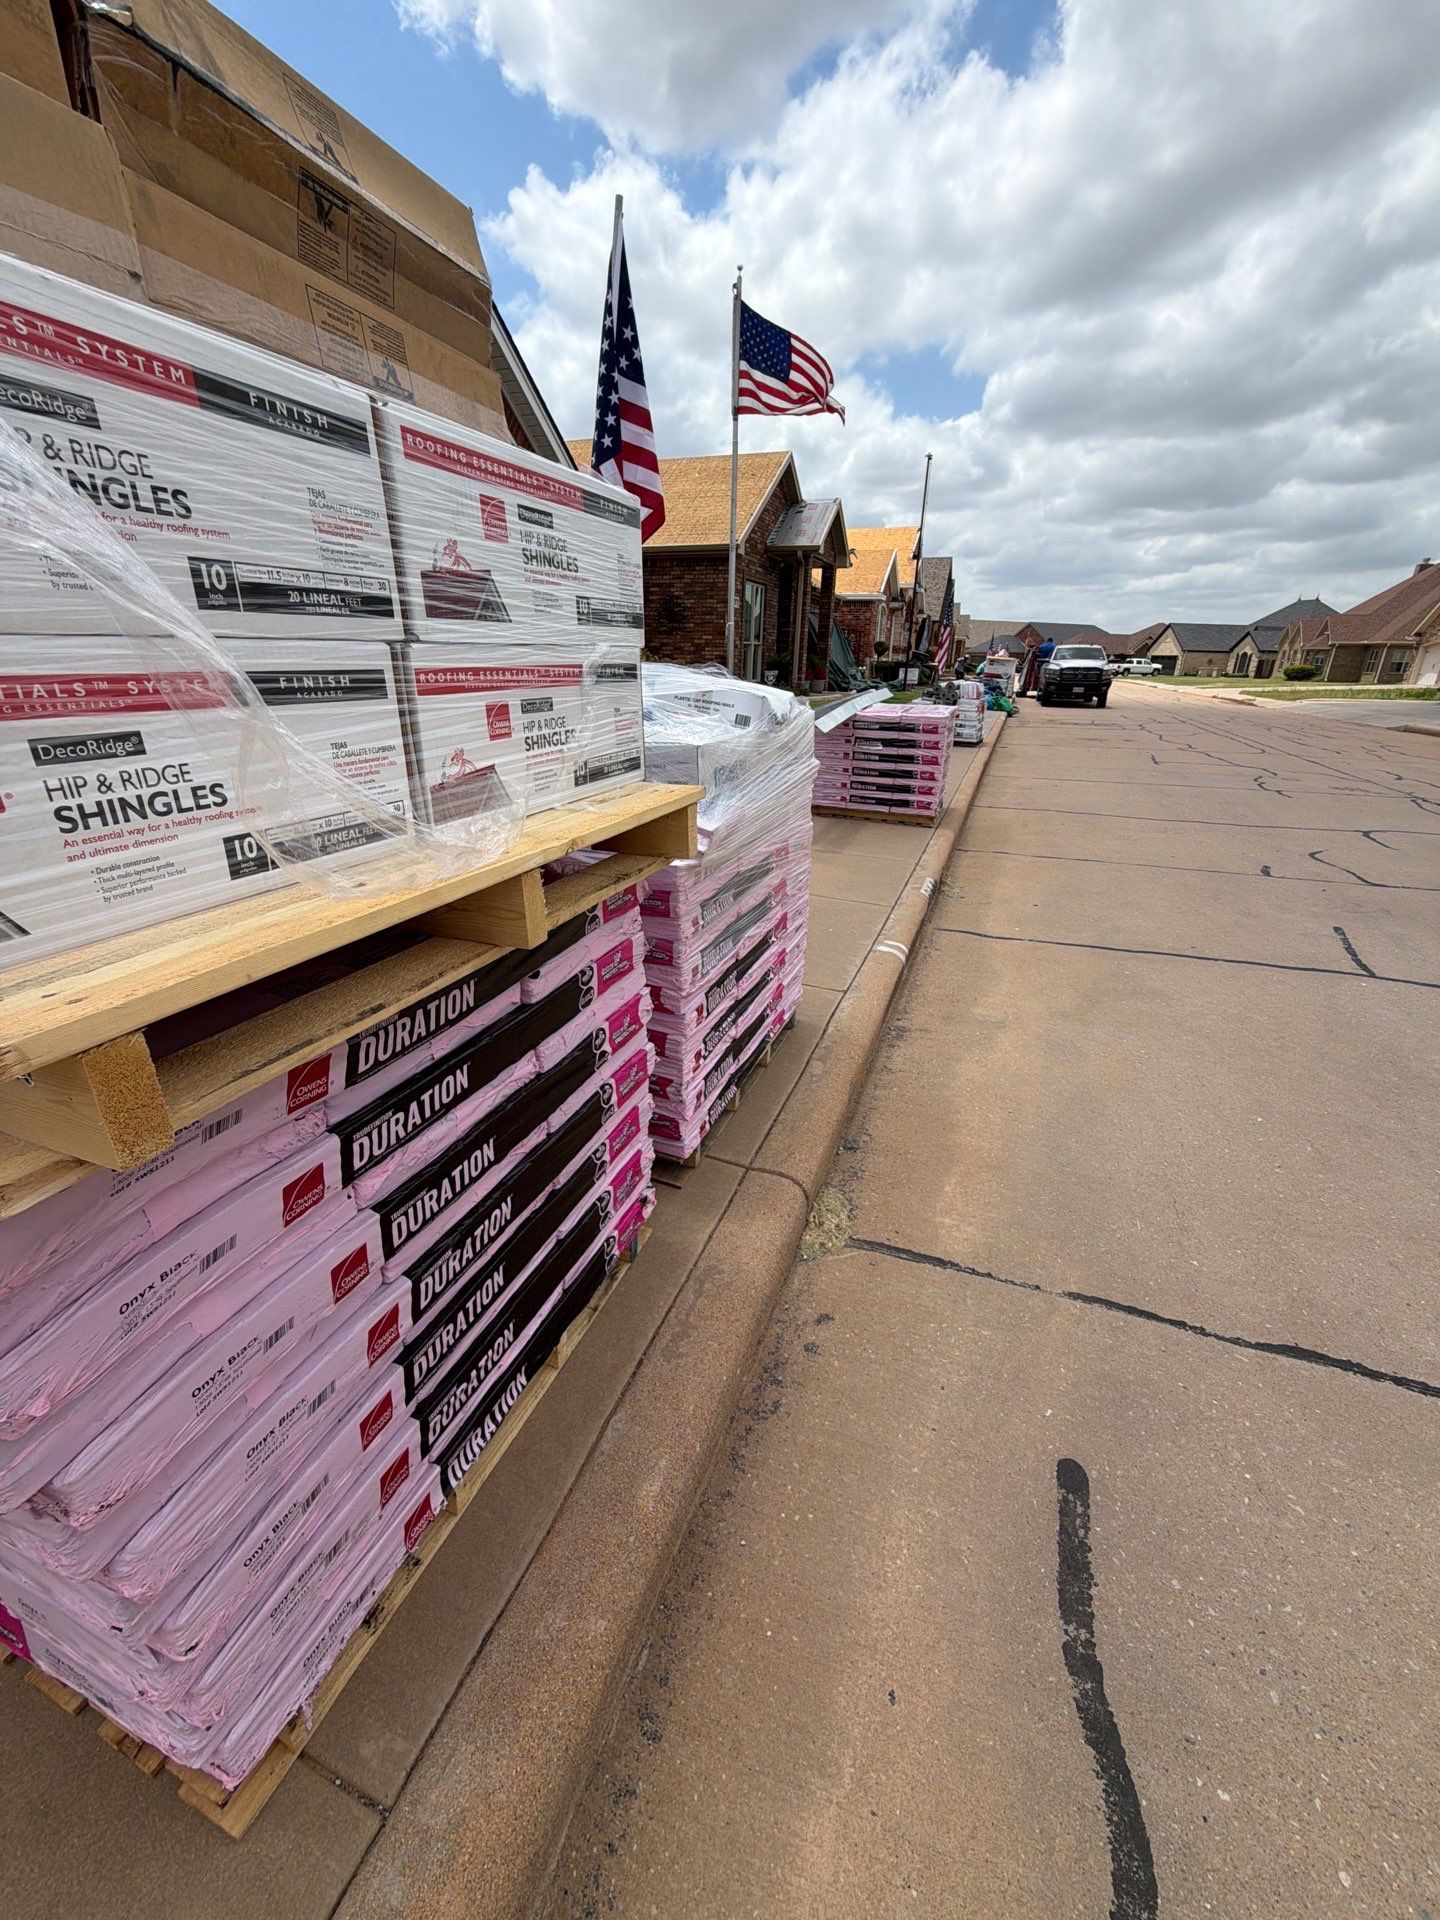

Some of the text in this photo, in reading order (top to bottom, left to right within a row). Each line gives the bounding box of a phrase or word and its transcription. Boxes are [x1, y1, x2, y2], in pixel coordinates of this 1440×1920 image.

[76, 336, 186, 385] SYSTEM
[249, 392, 329, 429] FINISH
[267, 416, 320, 437] ACABADO
[42, 433, 66, 463] &
[68, 438, 154, 480] RIDGE
[406, 433, 467, 463] ROOFING
[550, 482, 582, 499] SYSTEM
[52, 466, 193, 520] NGLES
[307, 487, 326, 499] TEJAS
[101, 511, 231, 540] for a healthy roofing system
[536, 533, 543, 547] &
[543, 533, 568, 553] RIDGE
[522, 547, 579, 573] SHINGLES
[51, 580, 88, 591] by trusted
[200, 562, 227, 591] 10
[267, 569, 282, 581] 11.5
[302, 573, 311, 584] 10
[343, 577, 350, 587] 8
[377, 581, 387, 591] 30
[287, 590, 362, 608] 20 LINEAL FEET
[316, 607, 351, 615] LINEALES
[280, 675, 351, 689] FINISH
[419, 671, 474, 684] ROOFING
[550, 668, 580, 677] SYSTEM
[296, 690, 343, 698] ACABADO
[490, 727, 511, 736] CORNING
[523, 716, 567, 734] HIP & RIDGE
[330, 741, 348, 751] TEJAS
[332, 751, 340, 759] DE
[340, 747, 367, 759] CABALLETE
[43, 763, 194, 802] HIP & RIDGE
[53, 783, 228, 834] SHINGLES
[63, 811, 234, 849] An essential way for a healthy roofing
[324, 818, 333, 828] 10
[324, 826, 363, 846] LINEAL
[67, 833, 179, 863] and ultimate dimension
[234, 837, 258, 861] 10
[96, 855, 161, 875] Durable construction
[97, 862, 175, 885] Thick multi-layered profile
[101, 868, 187, 894] Superior performance backed
[103, 885, 154, 904] by trusted brand
[358, 979, 476, 1074] DURATION
[290, 1085, 327, 1107] CORNING
[296, 1076, 327, 1096] OWENS
[352, 1063, 469, 1172] DURATION
[352, 1109, 394, 1142] TRUDEFINITION
[134, 1155, 176, 1184] SWS1211
[286, 1192, 323, 1220] CORNING
[293, 1183, 324, 1209] OWENS
[391, 1137, 495, 1249] DURATION
[420, 1195, 512, 1311] DURATION
[119, 1249, 199, 1315] Onyx Black
[336, 1268, 368, 1298] CORNING
[341, 1262, 367, 1287] OWENS
[413, 1264, 505, 1388] DURATION
[371, 1329, 398, 1362] CORNING
[191, 1334, 260, 1399] Onyx Black
[428, 1321, 515, 1446] DURATION
[246, 1394, 308, 1459] Onyx Black
[448, 1365, 528, 1488] DURATION
[243, 1499, 300, 1568] Onyx Black
[328, 1598, 352, 1634] Black
